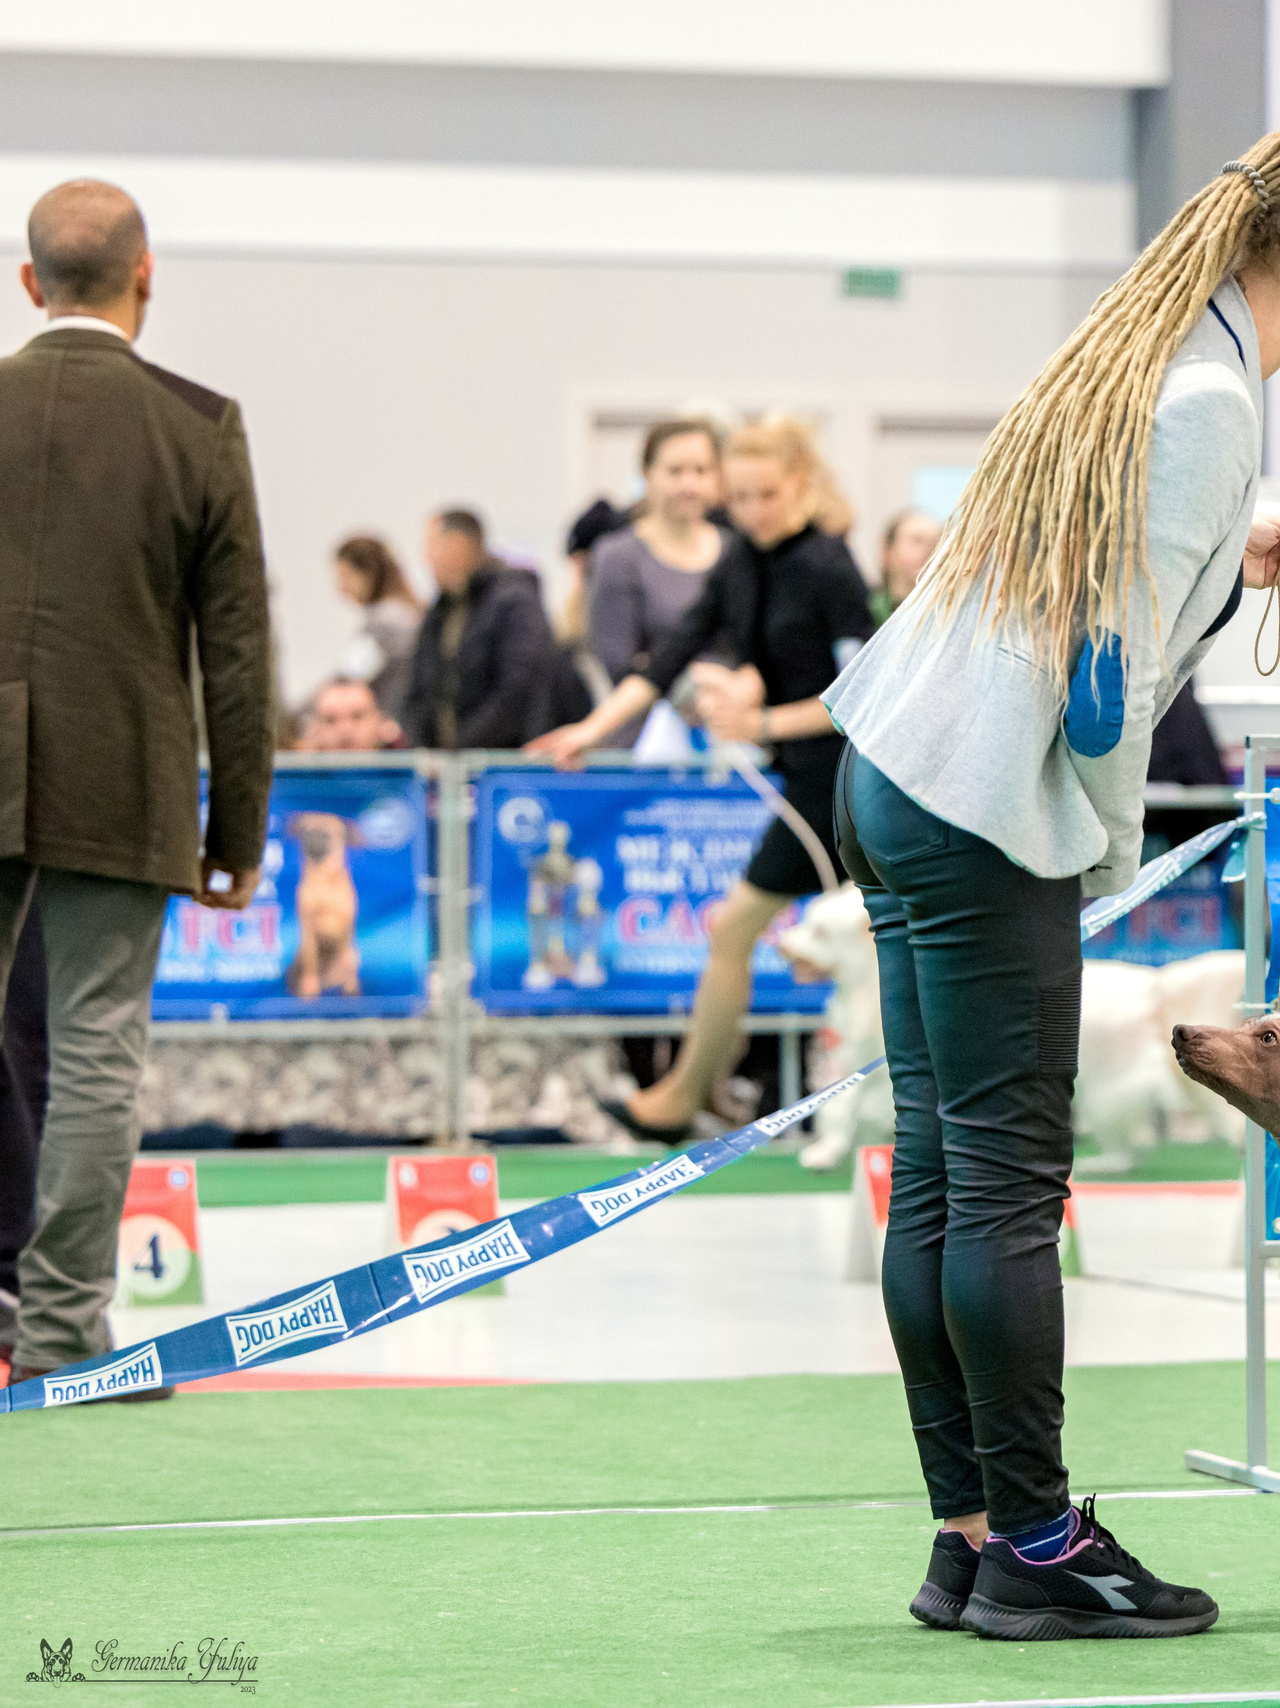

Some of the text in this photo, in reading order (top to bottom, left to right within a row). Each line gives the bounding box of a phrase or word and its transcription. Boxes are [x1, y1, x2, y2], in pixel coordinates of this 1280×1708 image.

[589, 1191, 633, 1218] DOG
[132, 1232, 166, 1281] 4
[411, 1231, 520, 1290] HAPPY DOG
[235, 1292, 339, 1354] HAPPY DOG
[51, 1353, 157, 1403] HAPPY DOG
